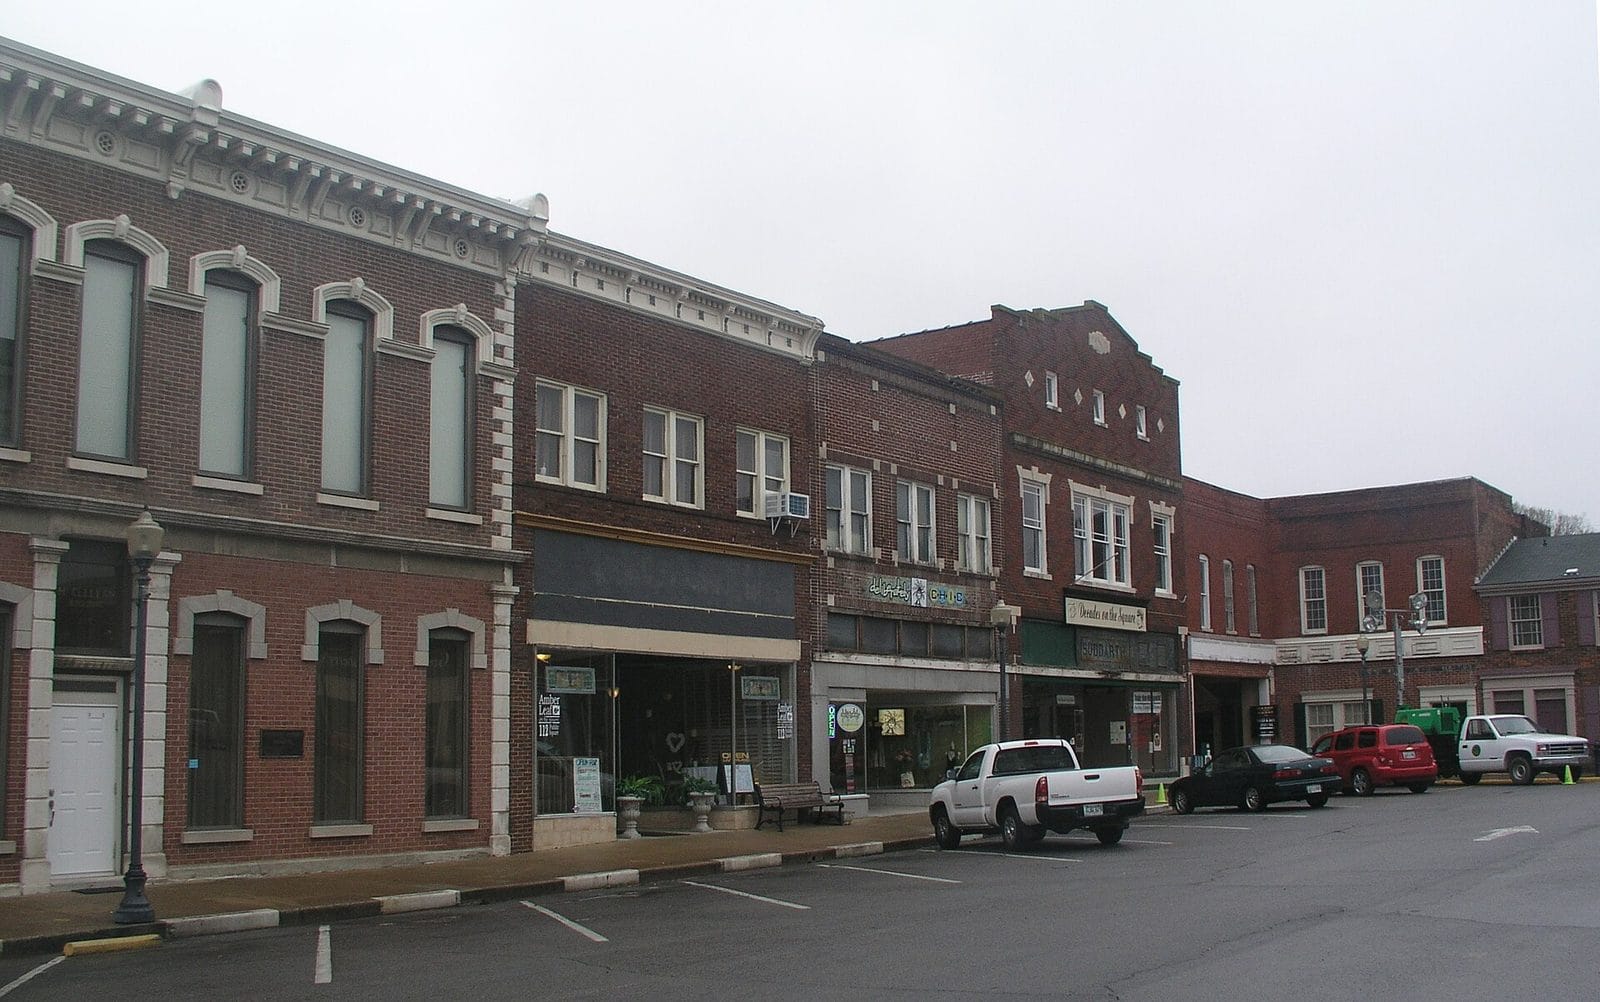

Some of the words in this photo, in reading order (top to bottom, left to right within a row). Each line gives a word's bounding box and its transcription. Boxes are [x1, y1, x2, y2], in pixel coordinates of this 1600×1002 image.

[1079, 602, 1101, 620] Decades
[1101, 610, 1109, 621] on
[1118, 607, 1137, 625] Square
[539, 694, 560, 705] Amber
[539, 705, 553, 715] Leaf
[828, 706, 836, 738] OPEN
